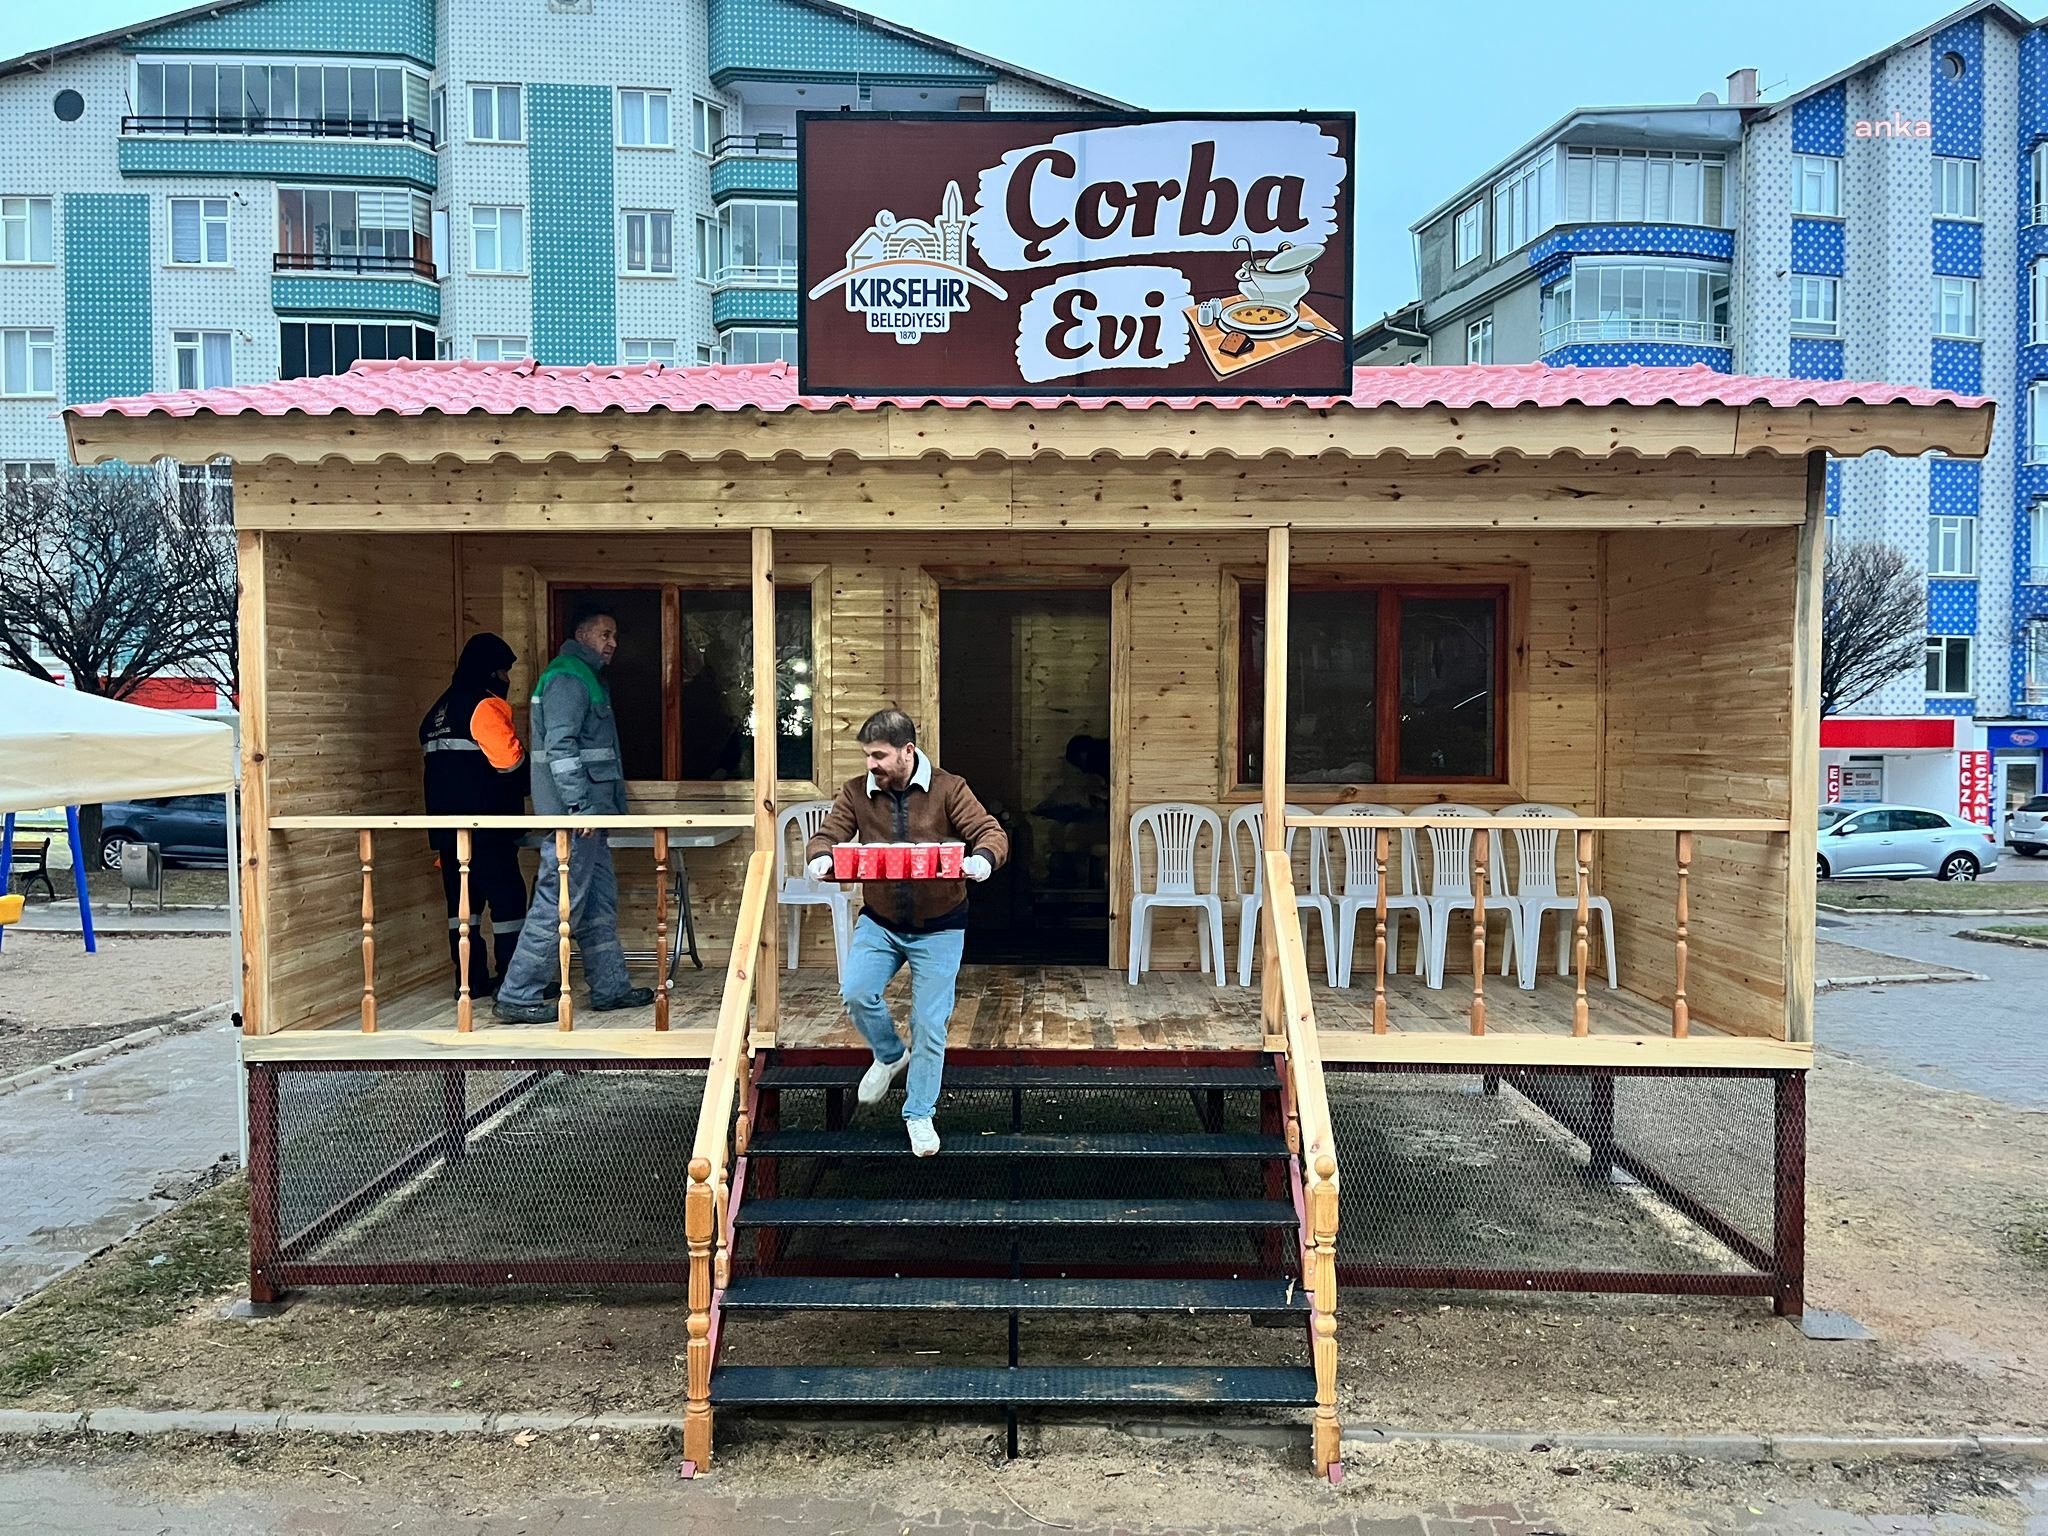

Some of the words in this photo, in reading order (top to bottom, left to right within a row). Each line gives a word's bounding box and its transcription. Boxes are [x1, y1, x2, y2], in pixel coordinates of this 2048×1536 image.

[1005, 140, 1309, 261] Çorba
[850, 278, 965, 308] KIRŞEHİR
[871, 312, 945, 328] BELEDİYESİ
[900, 330, 917, 340] 1870
[1045, 290, 1163, 360] Evi
